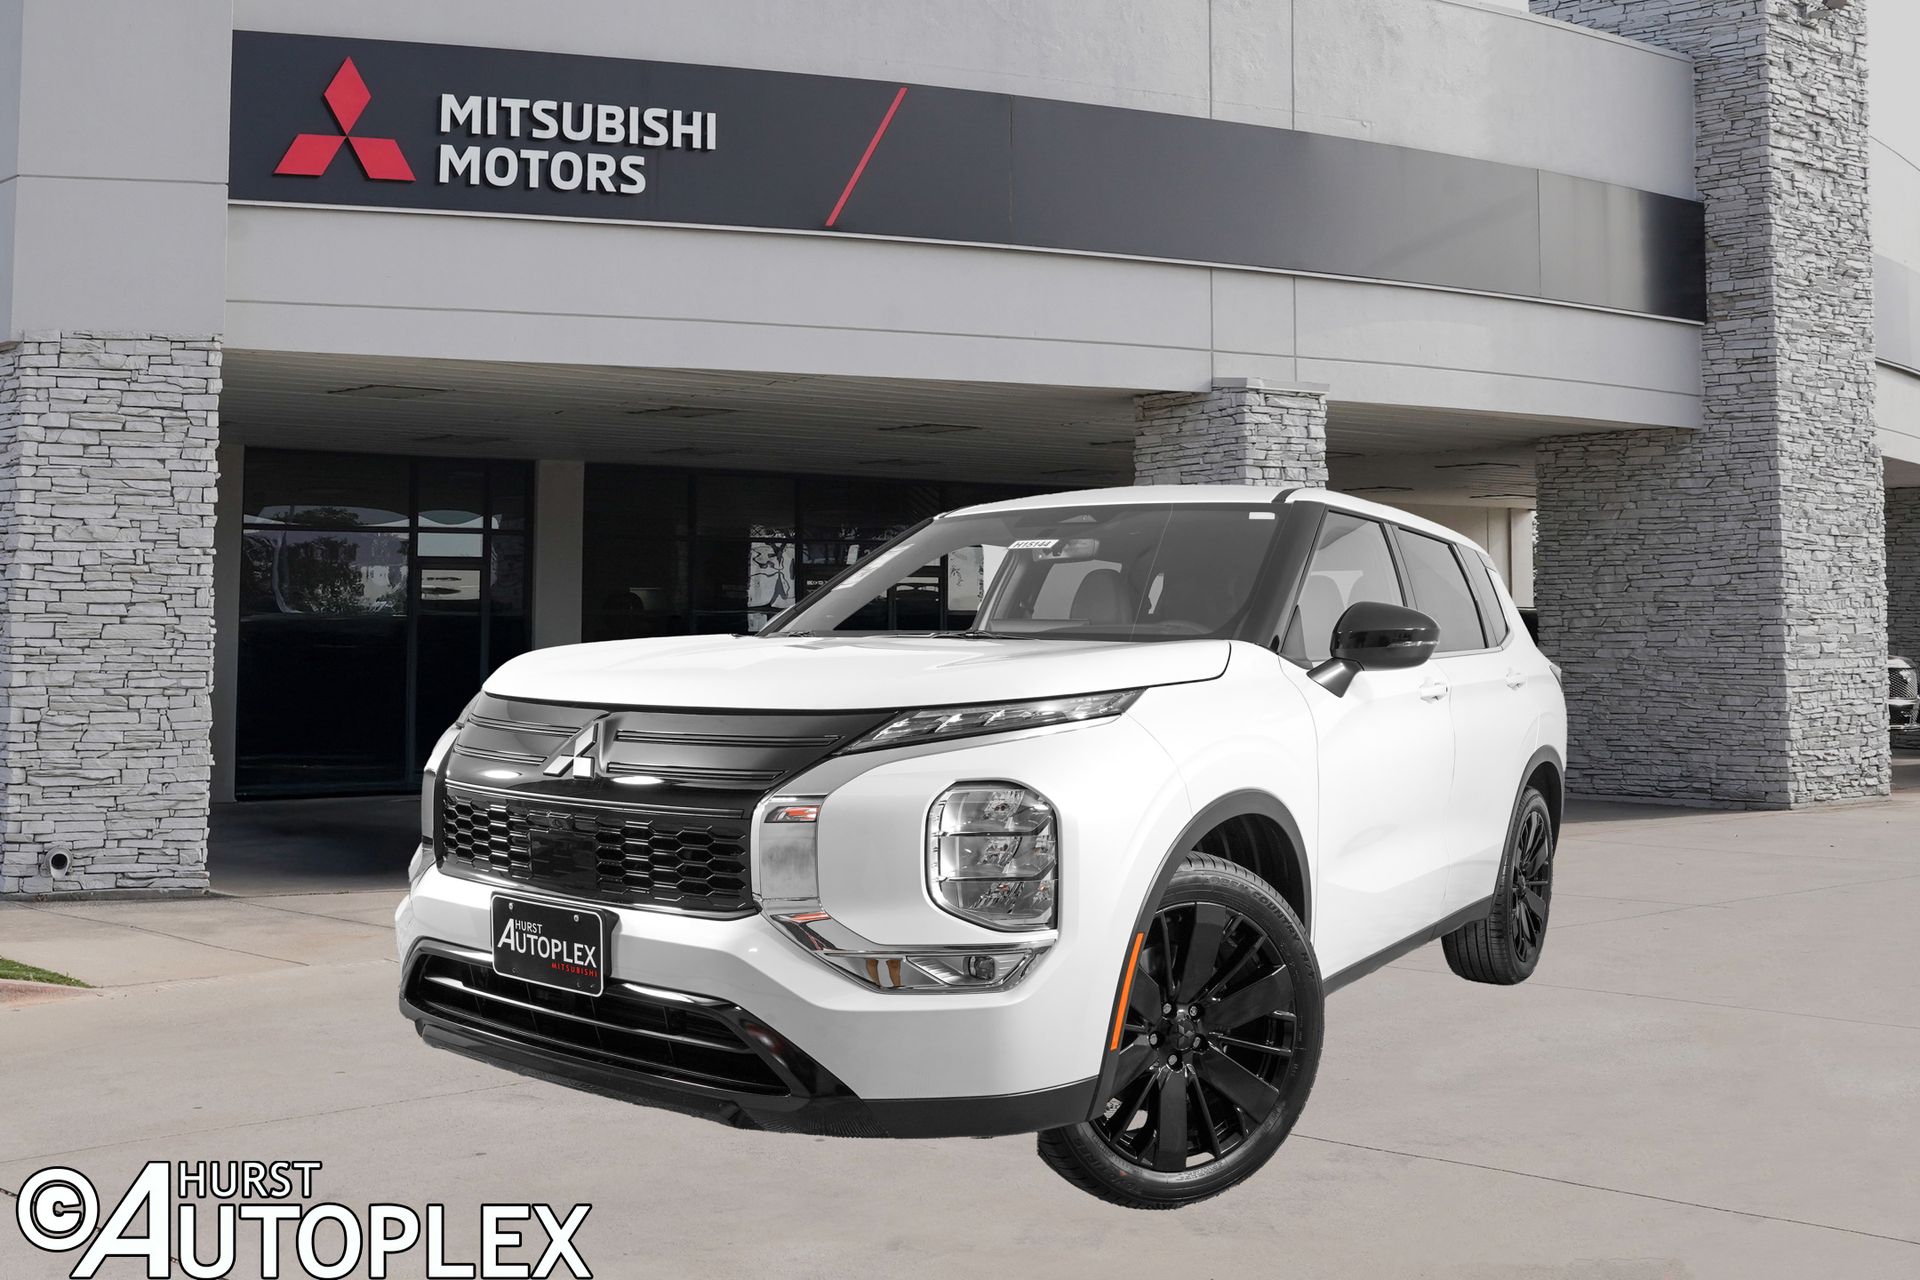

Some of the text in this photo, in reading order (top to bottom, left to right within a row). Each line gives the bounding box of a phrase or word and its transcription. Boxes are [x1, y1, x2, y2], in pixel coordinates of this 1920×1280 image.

[440, 93, 717, 151] MITSUBISHI
[439, 144, 646, 194] MOTORS
[514, 919, 543, 934] HURST
[1252, 891, 1302, 942] COUNTRY
[497, 918, 598, 968] AUTOPLEX
[550, 962, 598, 978] MITSUBISHI
